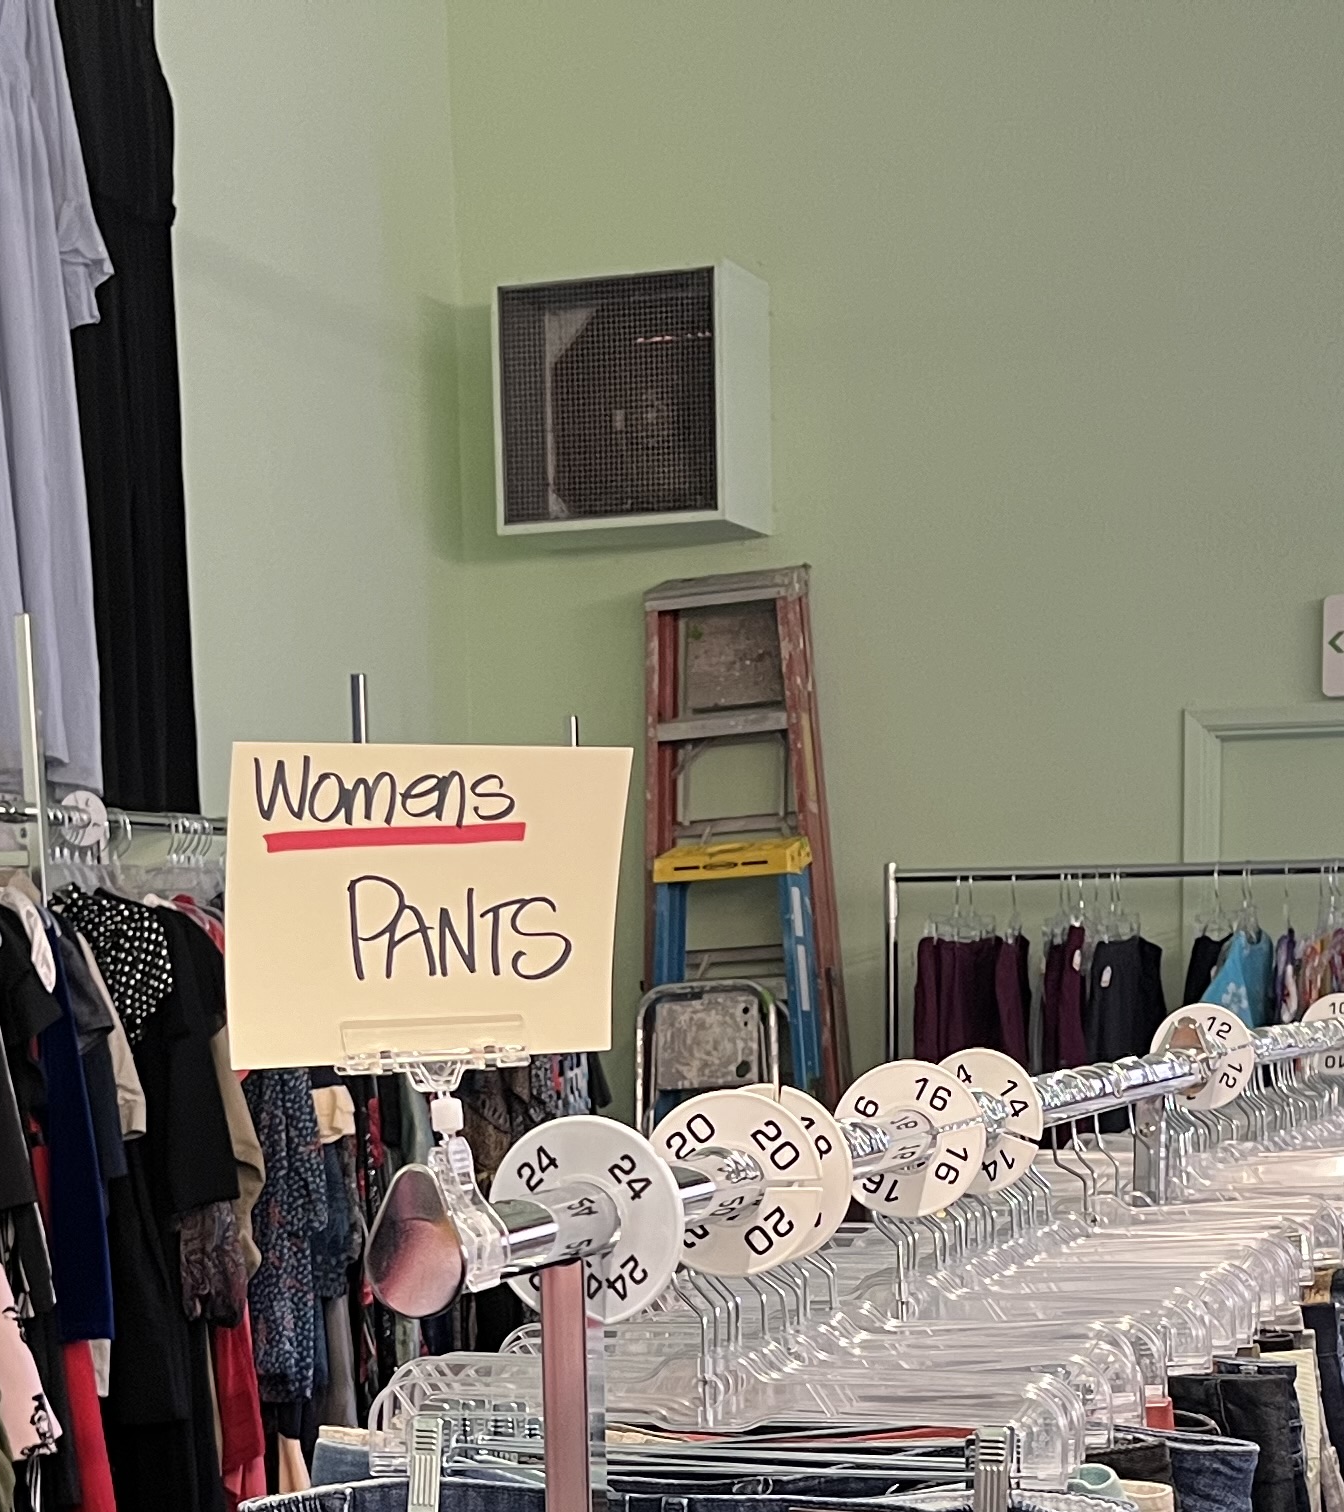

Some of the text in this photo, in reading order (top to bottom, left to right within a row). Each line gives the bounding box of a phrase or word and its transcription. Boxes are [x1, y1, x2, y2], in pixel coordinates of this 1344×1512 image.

[253, 755, 516, 828] Womens
[347, 874, 572, 980] PANTS
[1207, 1016, 1233, 1041] 12
[915, 1077, 952, 1112] 16
[1000, 1079, 1029, 1118] 14
[1218, 1063, 1243, 1089] 12
[665, 1113, 716, 1160] 20
[750, 1120, 800, 1171] 20
[516, 1145, 559, 1192] 24
[607, 1154, 653, 1201] 24
[862, 1173, 899, 1203] 16
[934, 1147, 969, 1185] 16
[981, 1149, 1016, 1182] 14
[744, 1205, 795, 1256] 20
[606, 1254, 648, 1301] 24
